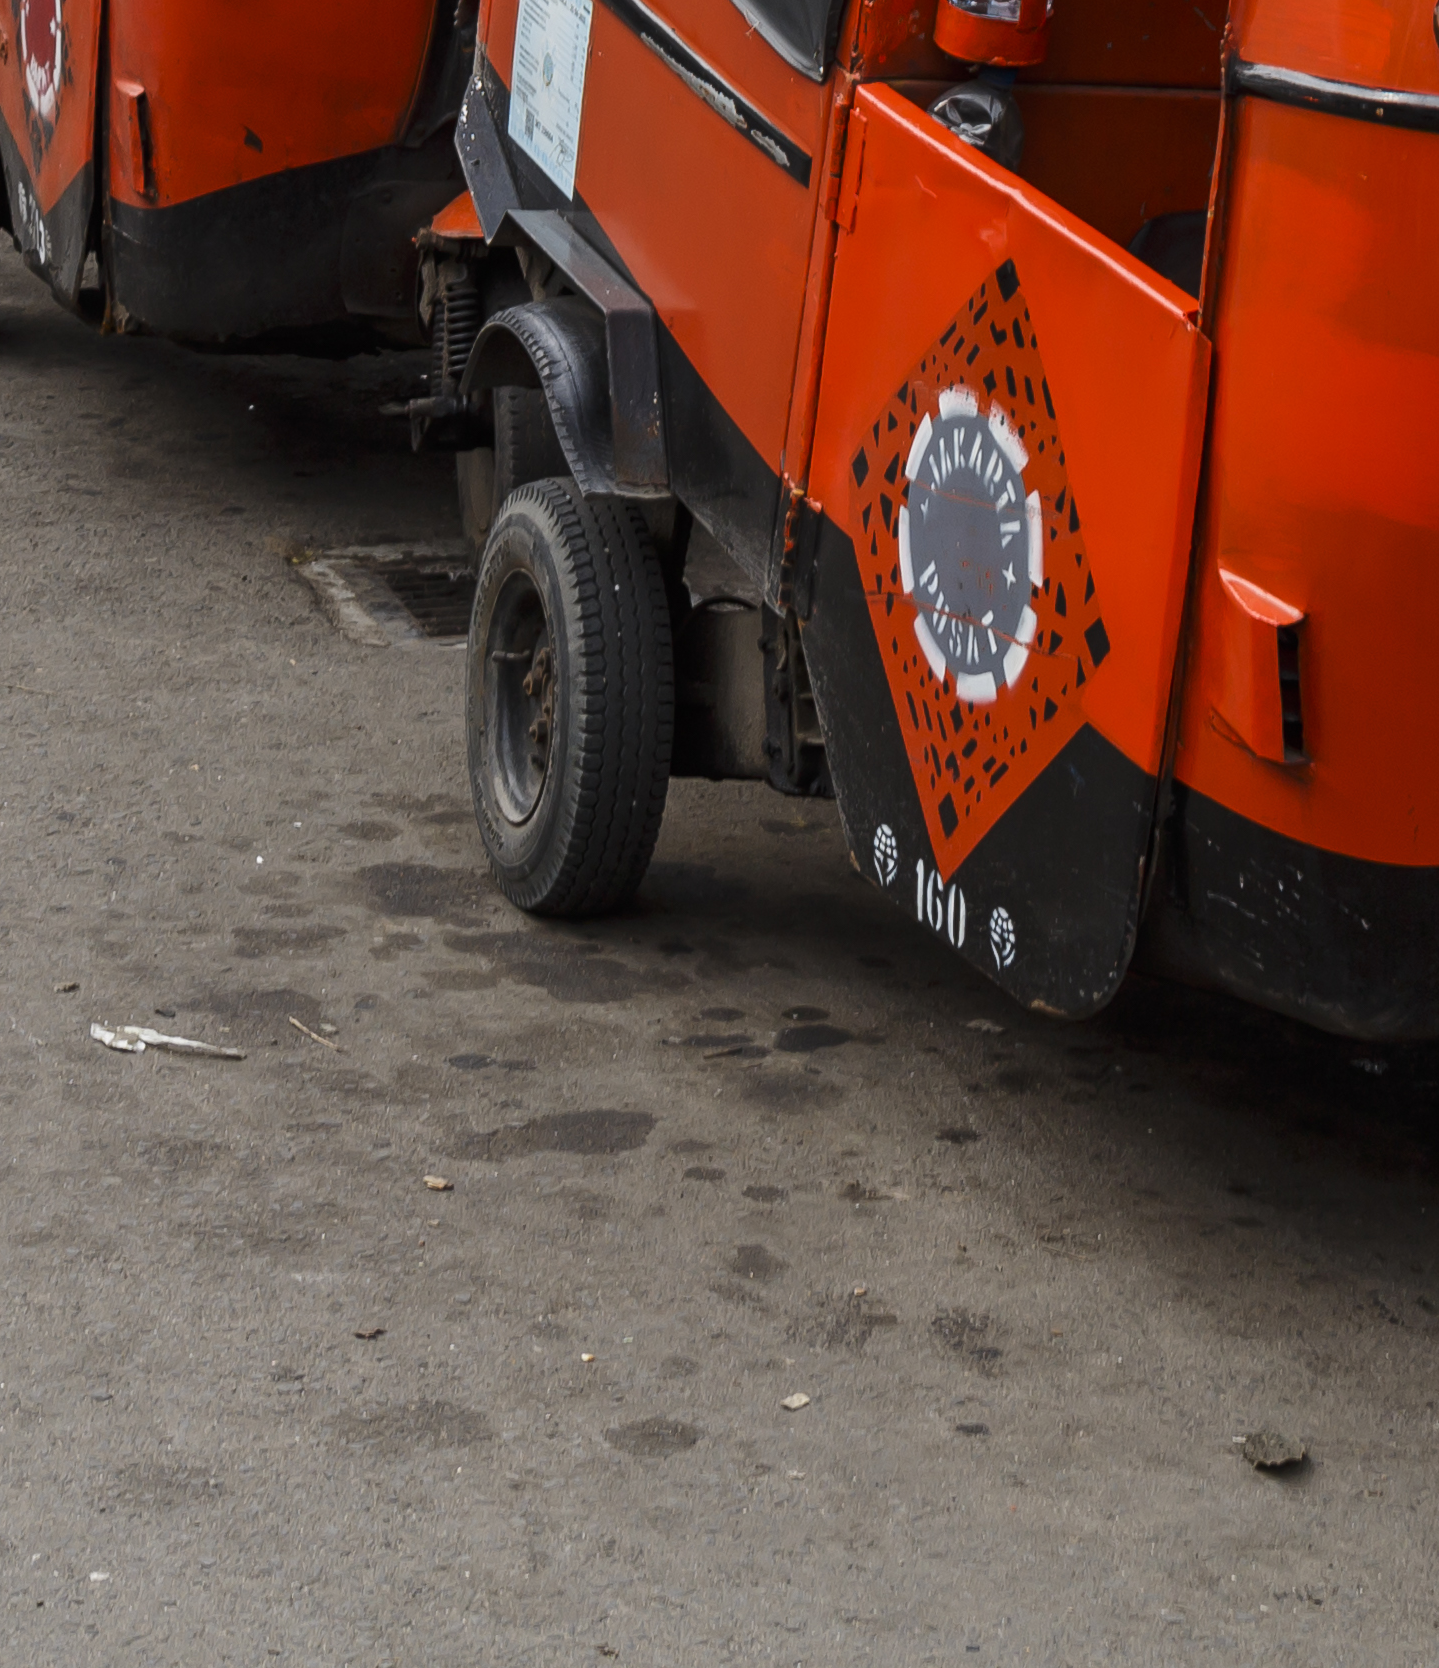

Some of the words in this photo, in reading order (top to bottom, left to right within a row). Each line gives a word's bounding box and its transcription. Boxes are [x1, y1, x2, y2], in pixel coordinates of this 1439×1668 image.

[927, 426, 1021, 550] JAKARTA
[918, 559, 998, 668] PUSAT
[916, 857, 967, 950] 160
